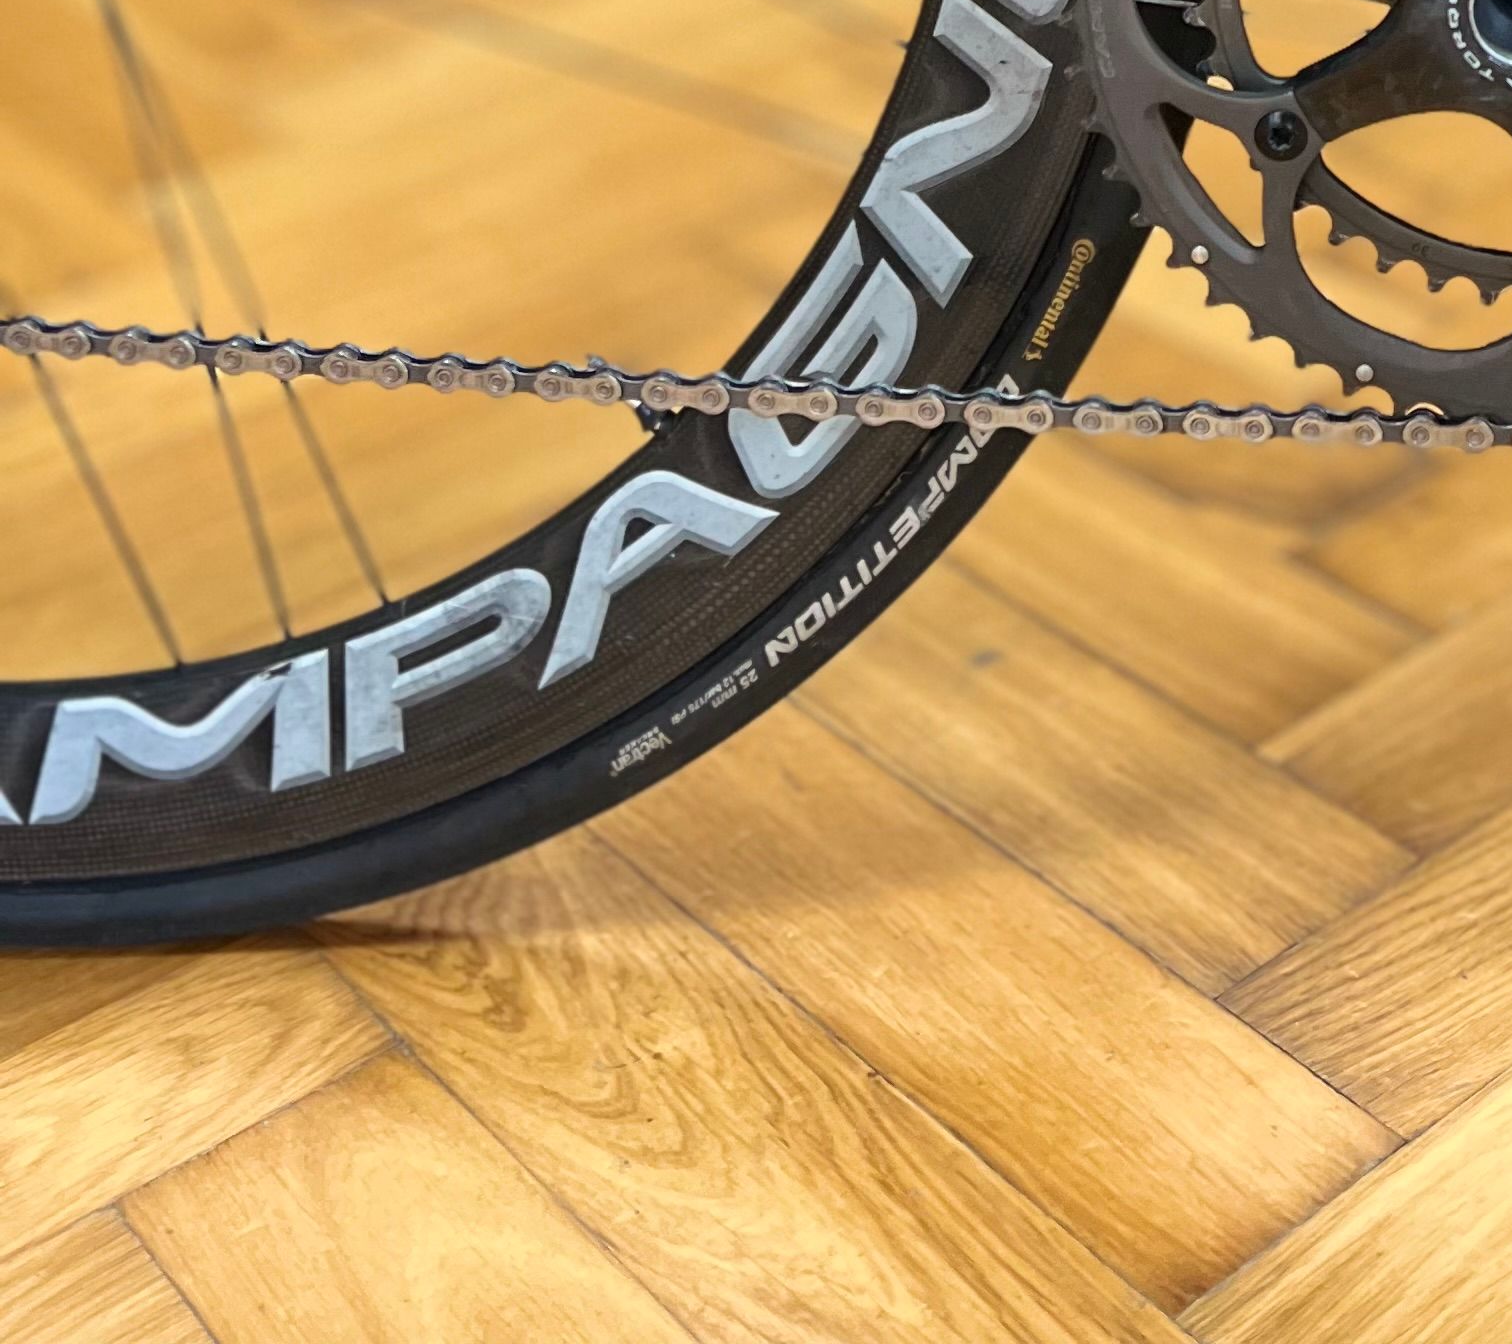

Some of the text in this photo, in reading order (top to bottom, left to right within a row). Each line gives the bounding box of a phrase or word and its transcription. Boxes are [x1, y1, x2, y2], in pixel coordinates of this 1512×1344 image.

[1031, 238, 1096, 352] Continental
[712, 668, 759, 709] 25 mm
